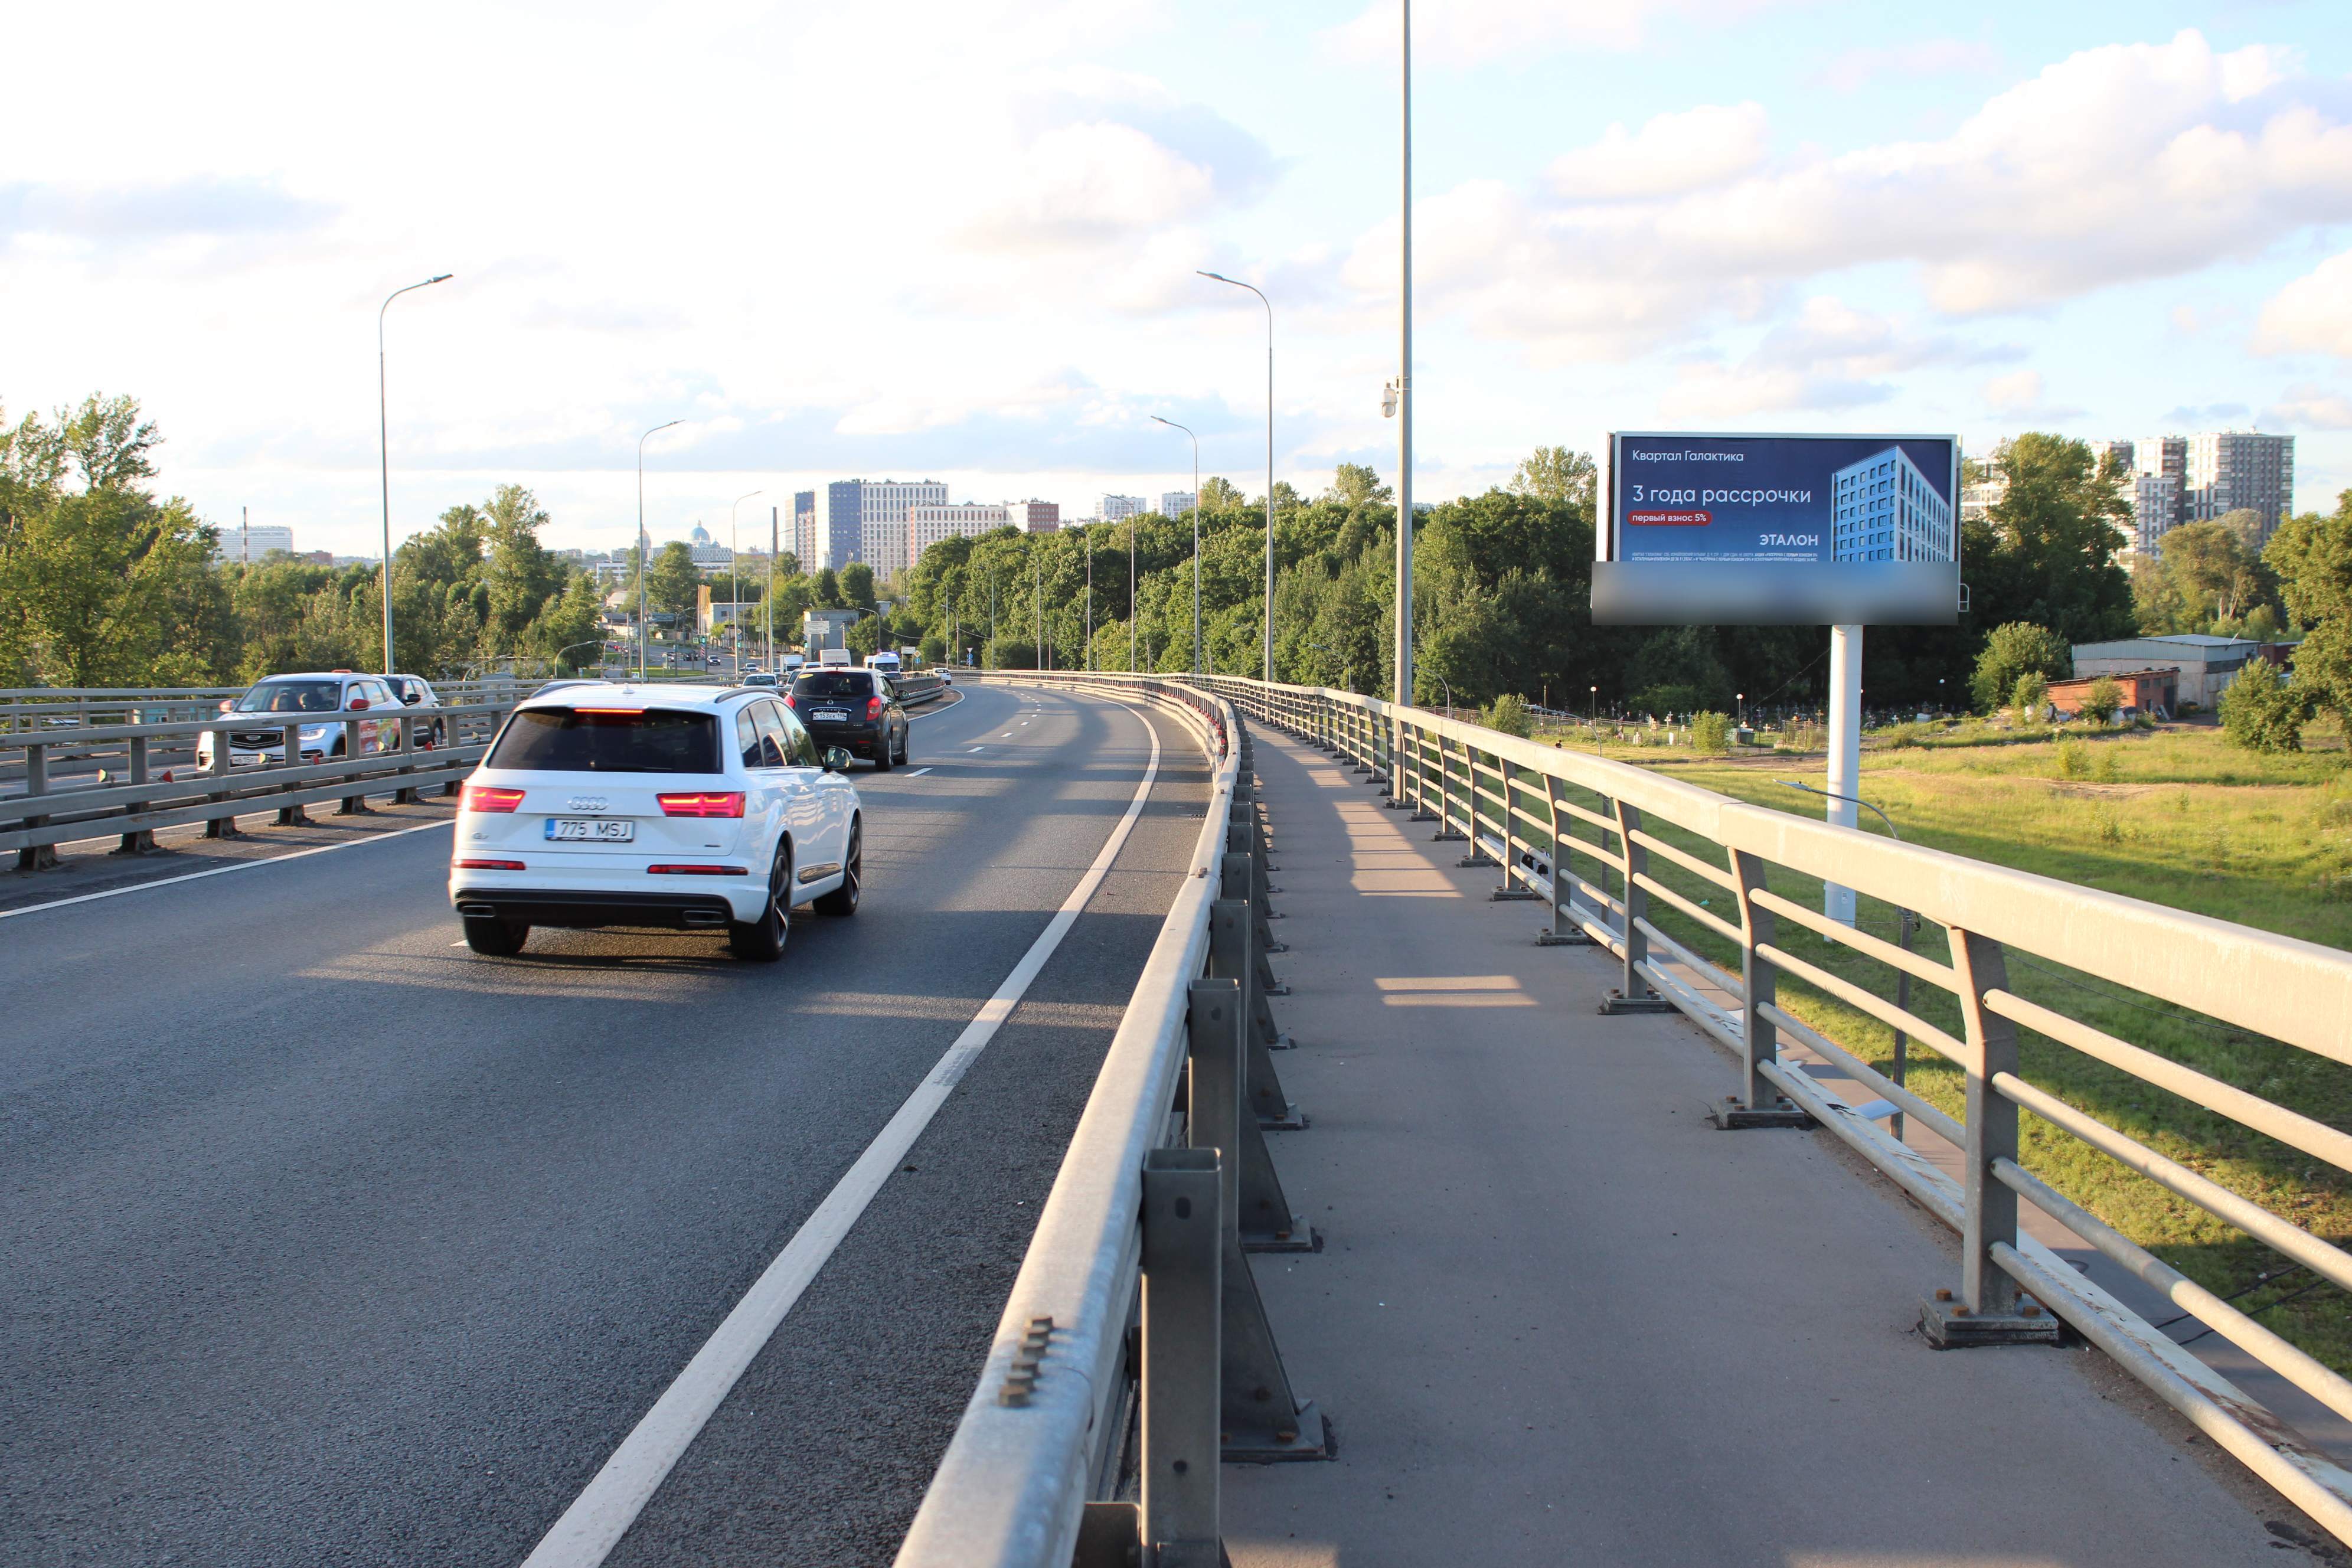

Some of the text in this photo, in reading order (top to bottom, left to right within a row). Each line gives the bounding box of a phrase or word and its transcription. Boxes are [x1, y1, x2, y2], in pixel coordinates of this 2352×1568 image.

[1632, 450, 1744, 463] Квартал Галактика
[1633, 485, 1811, 507] 3 года рассрочки
[1632, 514, 1665, 523] первый
[1695, 514, 1707, 522] 5%
[1759, 534, 1818, 546] ЭТАЛОН
[561, 822, 628, 837] 775 MSJ
